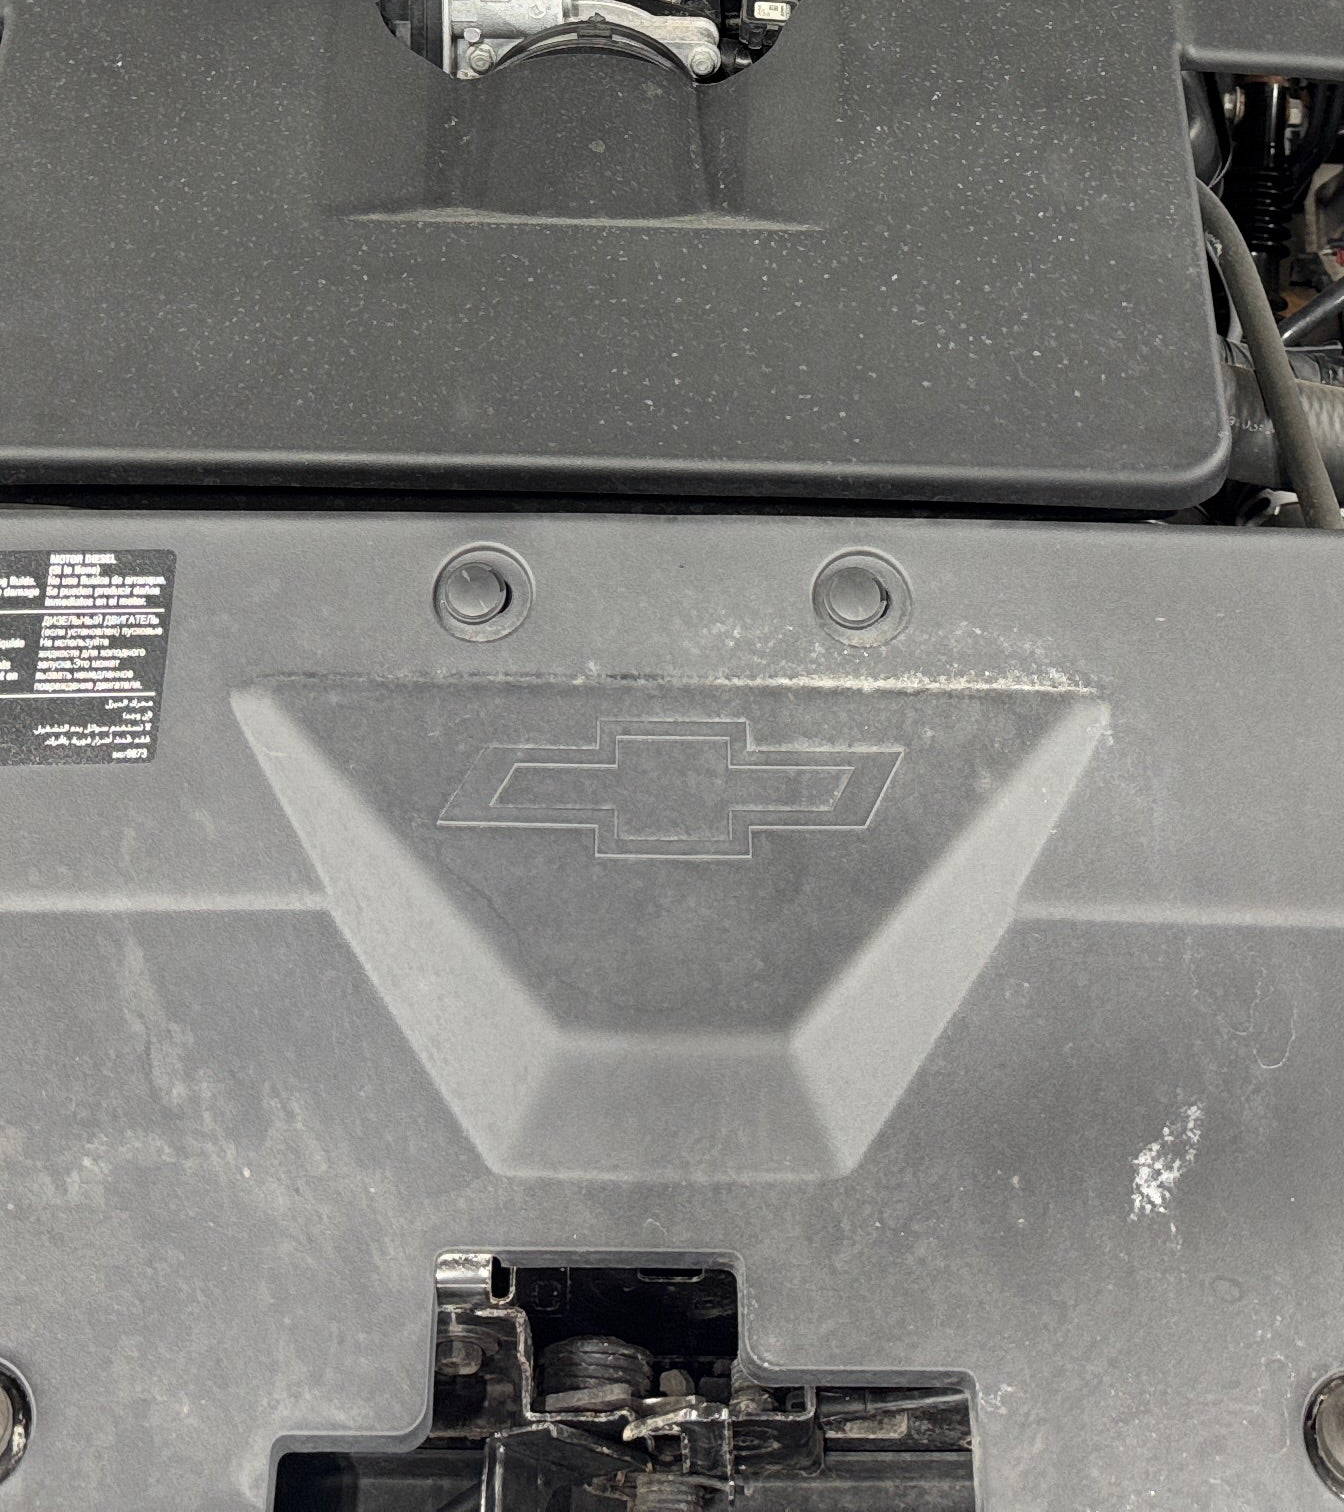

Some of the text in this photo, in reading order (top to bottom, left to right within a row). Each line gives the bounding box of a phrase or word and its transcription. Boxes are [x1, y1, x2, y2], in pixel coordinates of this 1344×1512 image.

[50, 553, 117, 564] MOTOR DIESEL
[103, 614, 160, 627] ДВИГАТЕЛЬ
